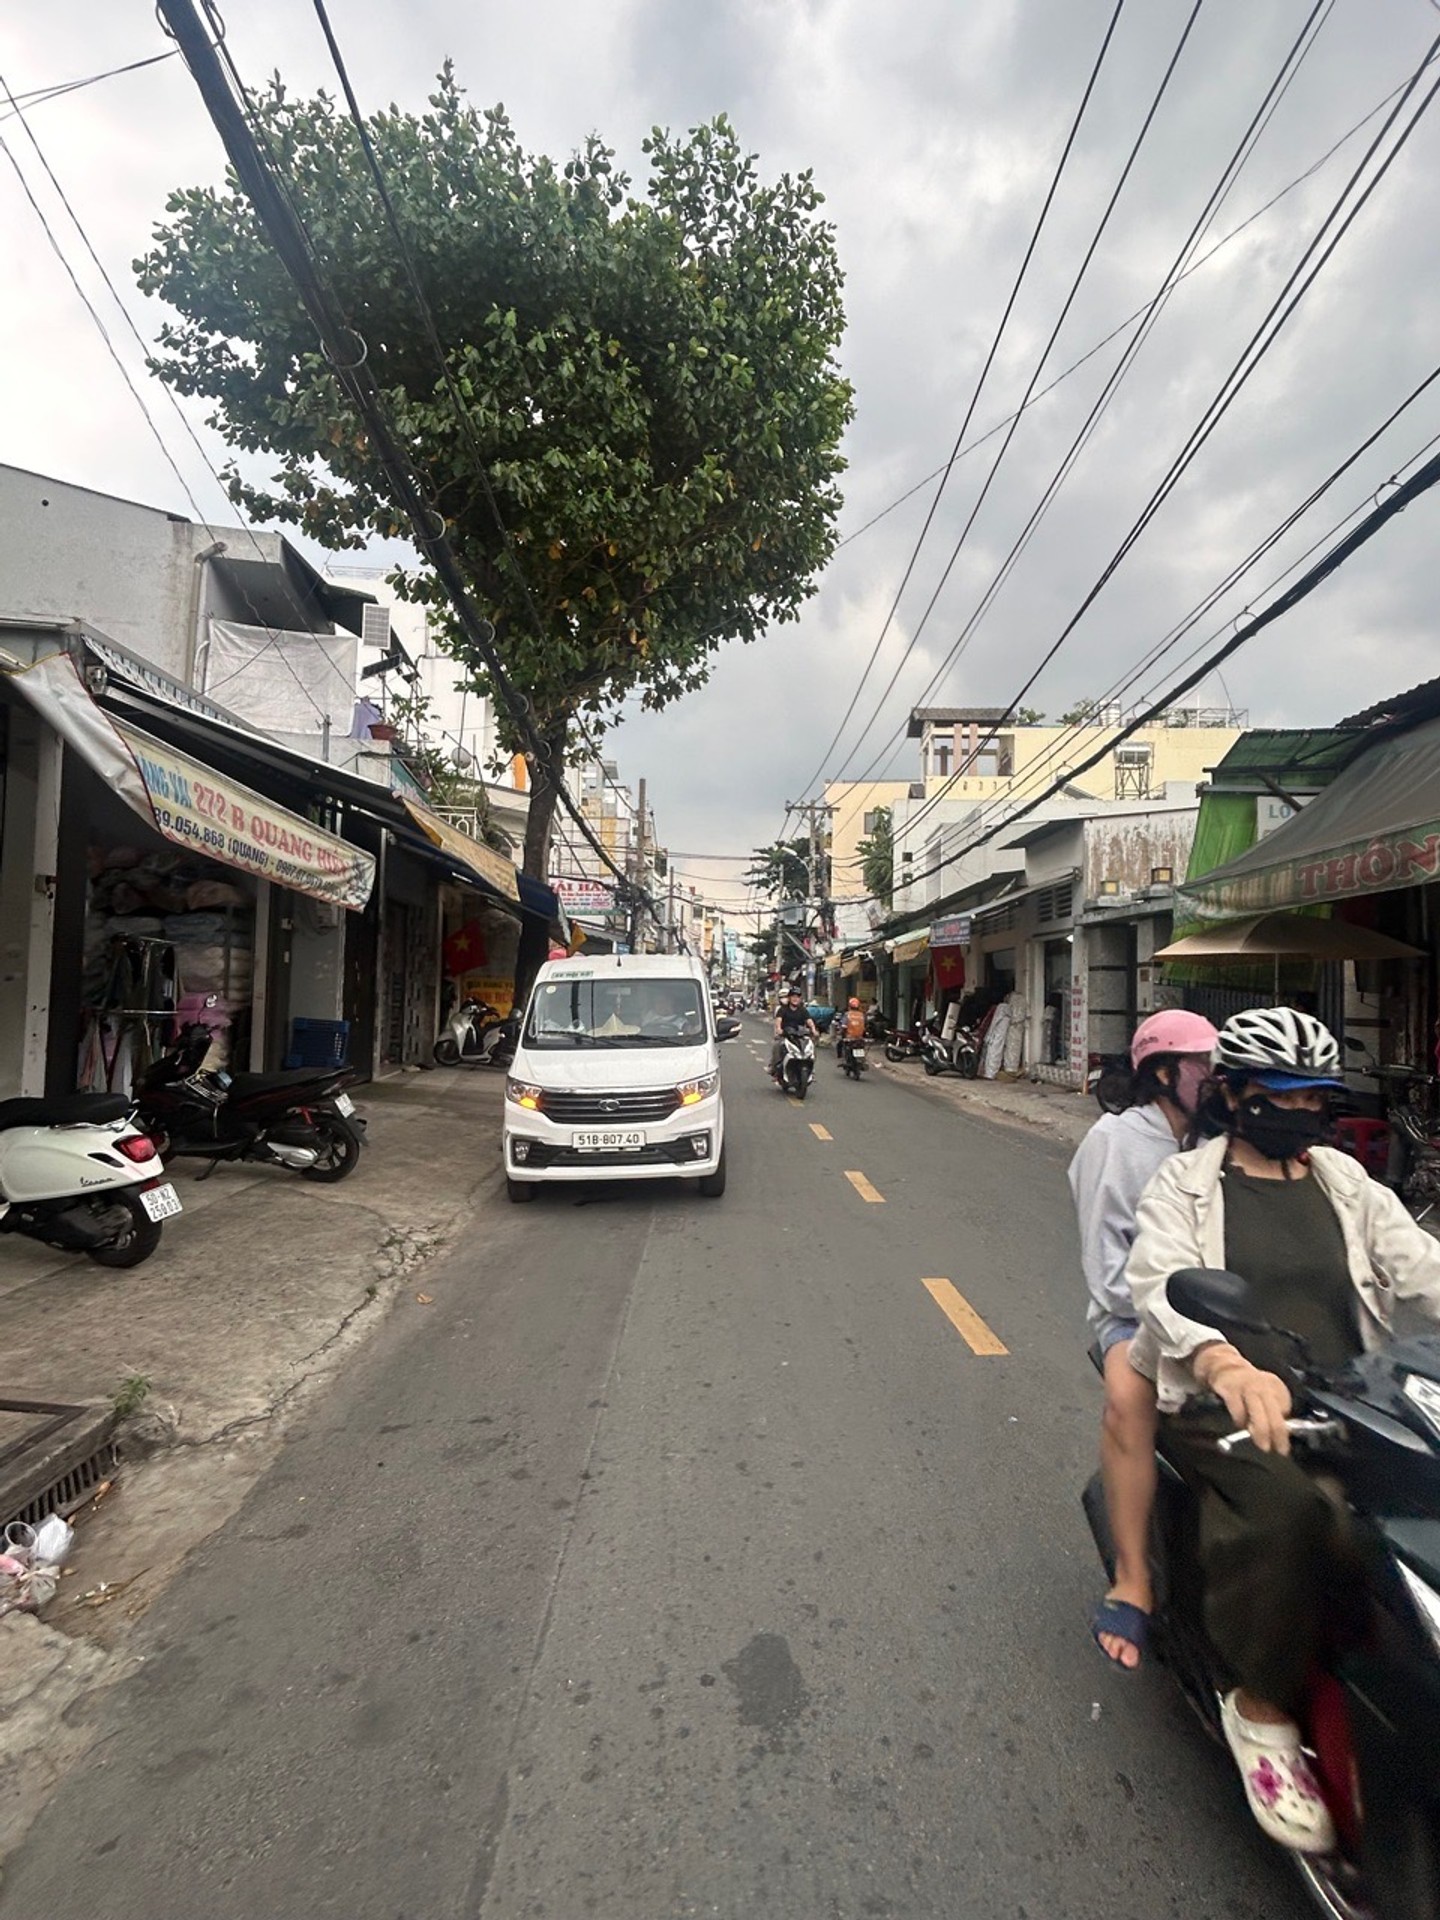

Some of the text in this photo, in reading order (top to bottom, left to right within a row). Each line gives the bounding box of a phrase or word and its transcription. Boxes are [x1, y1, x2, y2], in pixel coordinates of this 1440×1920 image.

[193, 781, 227, 825] 272
[231, 804, 245, 833] B
[251, 815, 312, 863] QUANG
[578, 1134, 640, 1145] 51B-807.40
